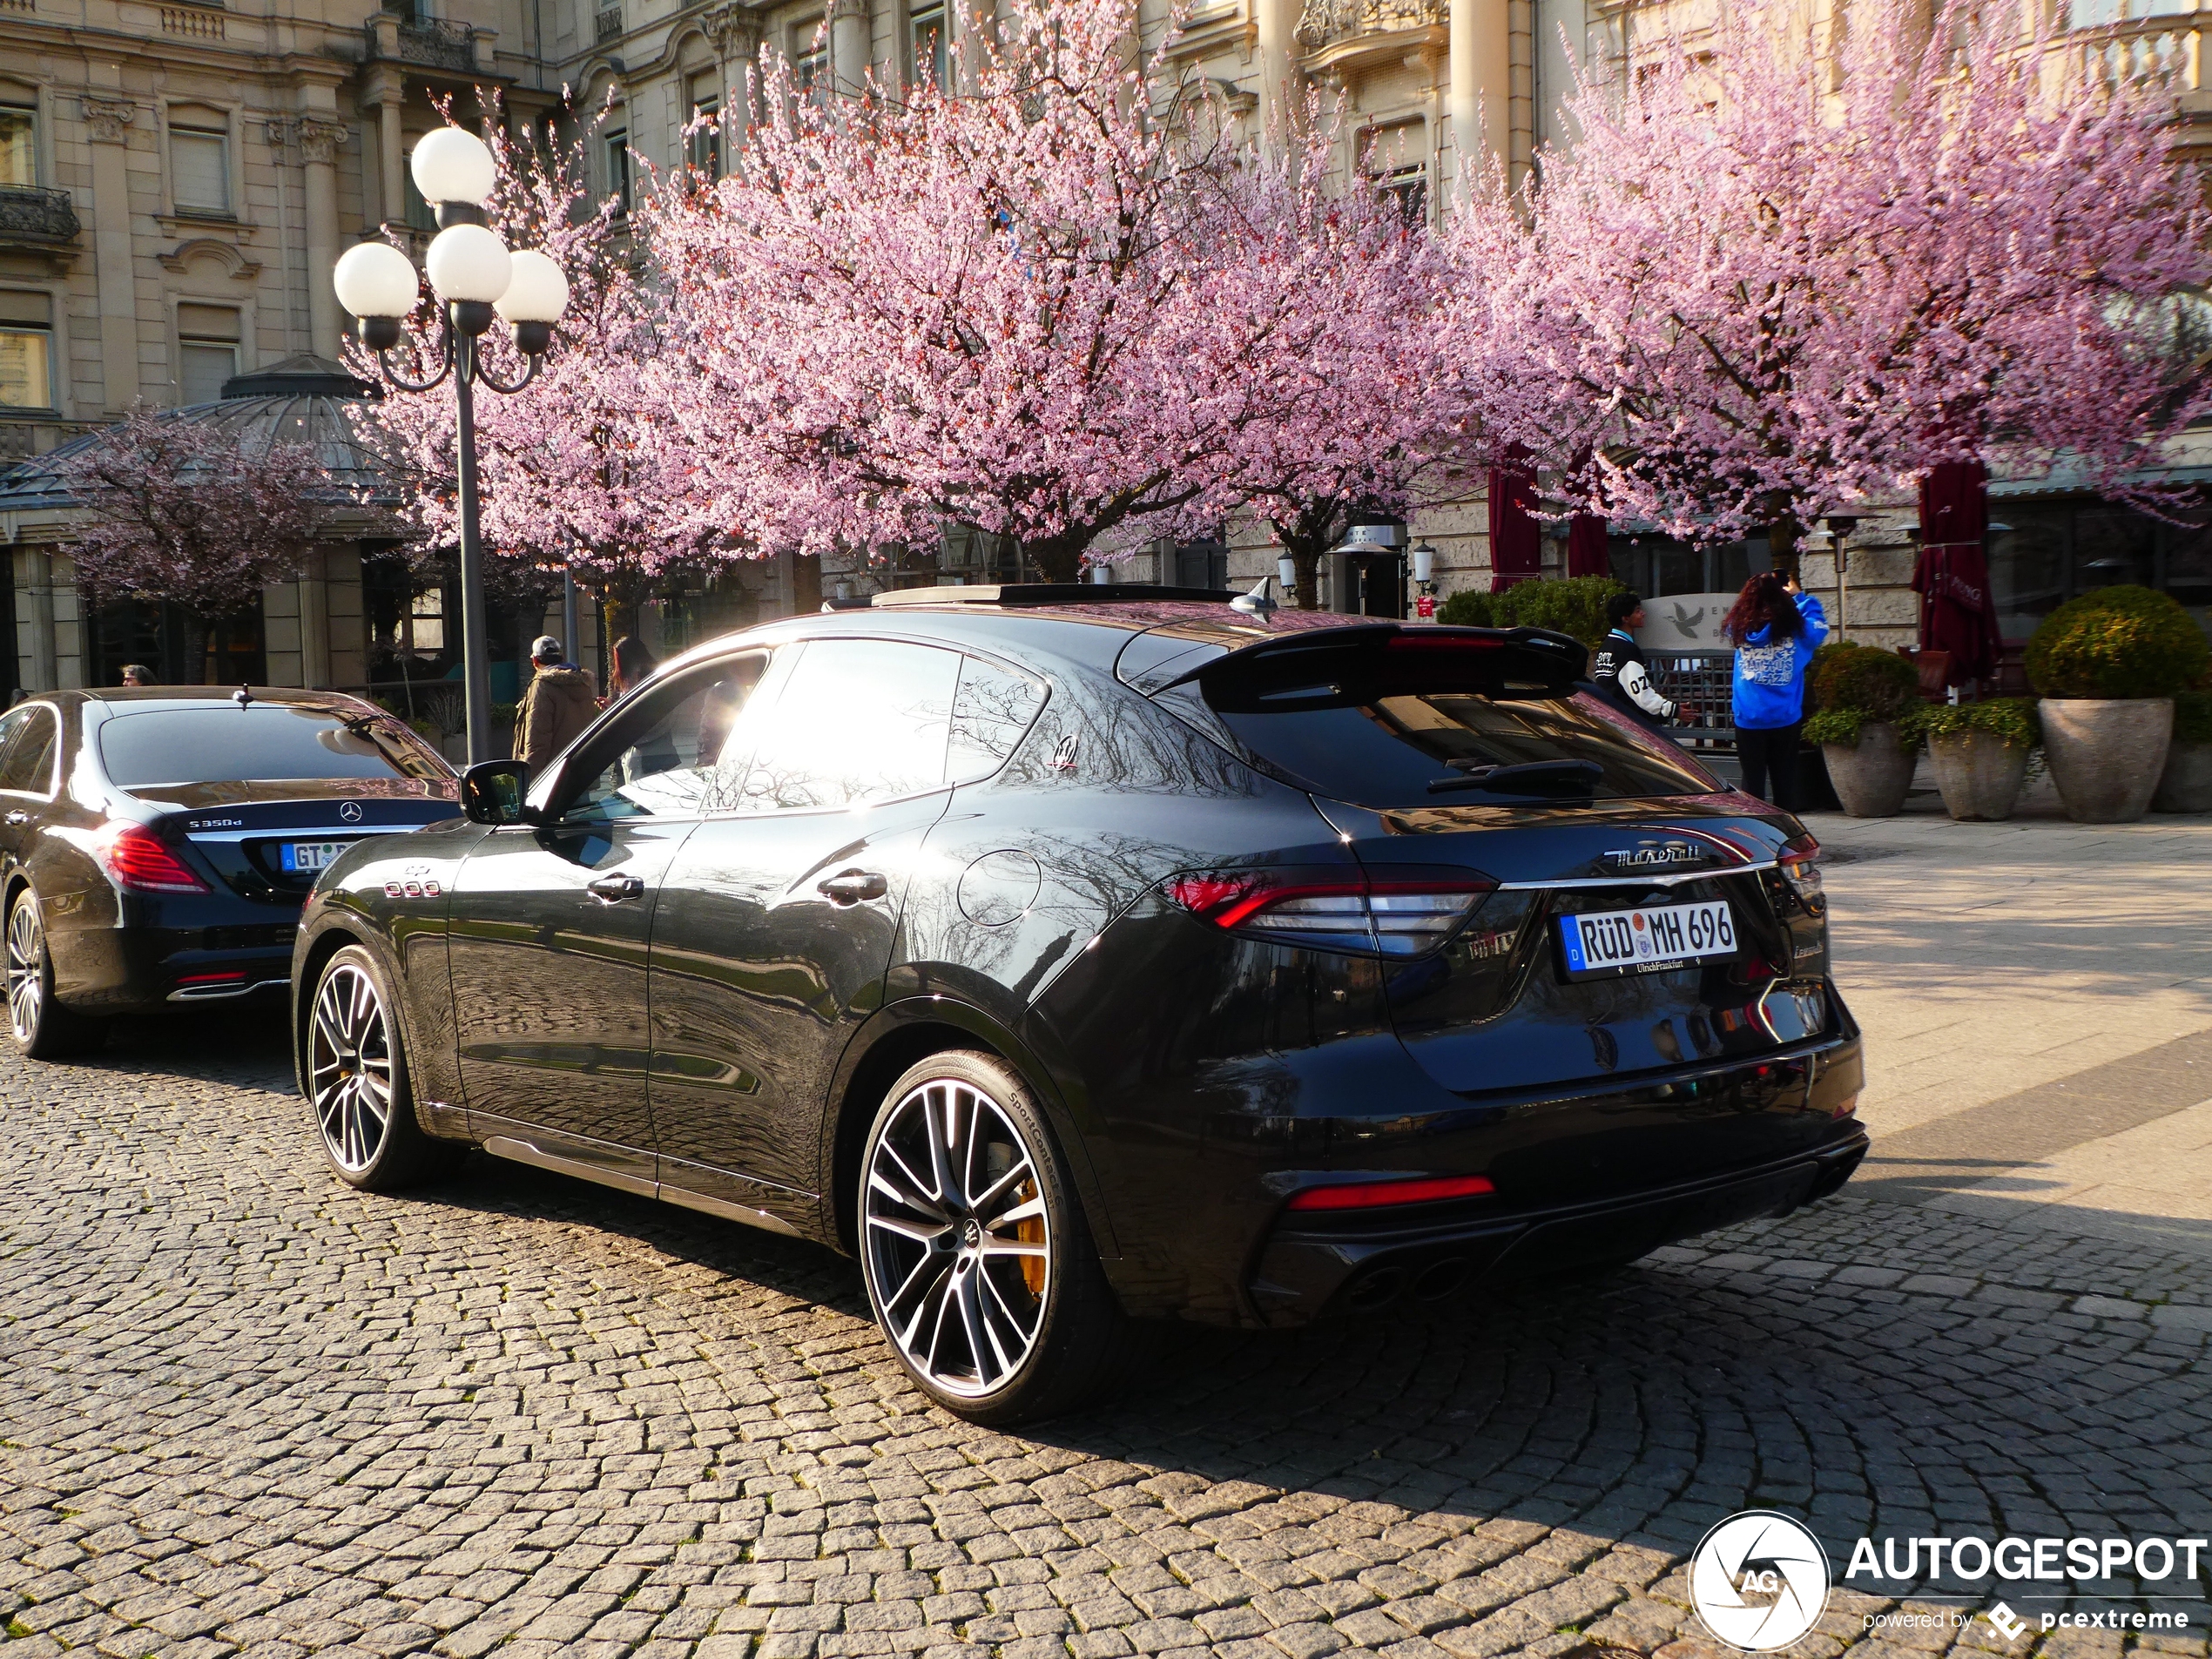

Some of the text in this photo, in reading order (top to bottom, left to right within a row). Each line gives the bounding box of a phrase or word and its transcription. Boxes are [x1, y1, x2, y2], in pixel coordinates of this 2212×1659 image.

[1629, 675, 1649, 695] 07
[201, 819, 242, 827] 350d
[296, 845, 320, 867] GT
[1603, 845, 1703, 867] Maserati
[1580, 907, 1733, 963] RÜD MH 696
[1571, 948, 1579, 961] D
[1008, 1091, 1060, 1191] SportContact
